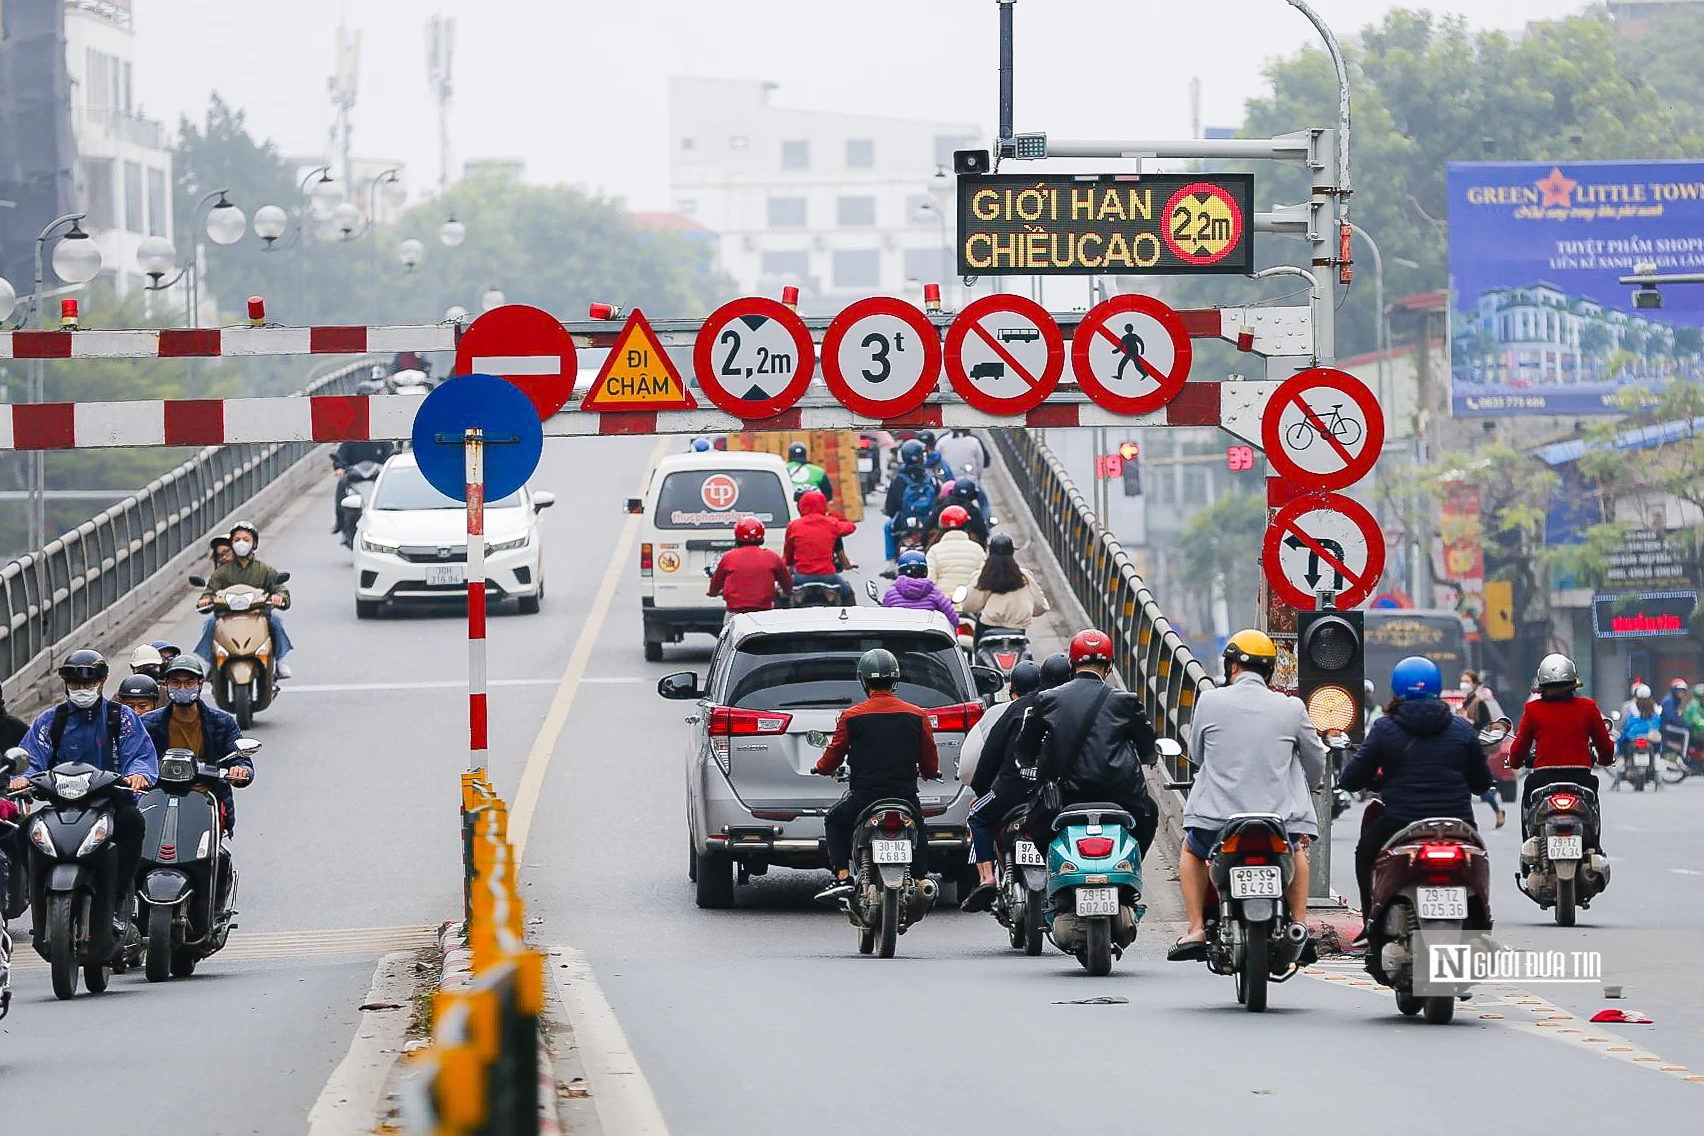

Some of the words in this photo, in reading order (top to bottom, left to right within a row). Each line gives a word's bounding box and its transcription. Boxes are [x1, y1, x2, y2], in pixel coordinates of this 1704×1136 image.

[972, 182, 1057, 221] GIỚI
[1071, 188, 1152, 221] HẠN
[1468, 185, 1539, 205] GREEN
[1576, 183, 1646, 203] LITTLE
[627, 349, 648, 368] ĐI
[720, 330, 791, 379] 2,2m
[606, 373, 670, 399] CHẬM
[1228, 446, 1254, 470] 39
[705, 482, 733, 506] tp
[879, 852, 907, 862] 4683
[1021, 853, 1041, 864] 868
[1082, 889, 1111, 901] 29-E1
[1241, 882, 1275, 894] 8429
[1080, 901, 1116, 914] 602.06
[1422, 903, 1464, 917] 025.36
